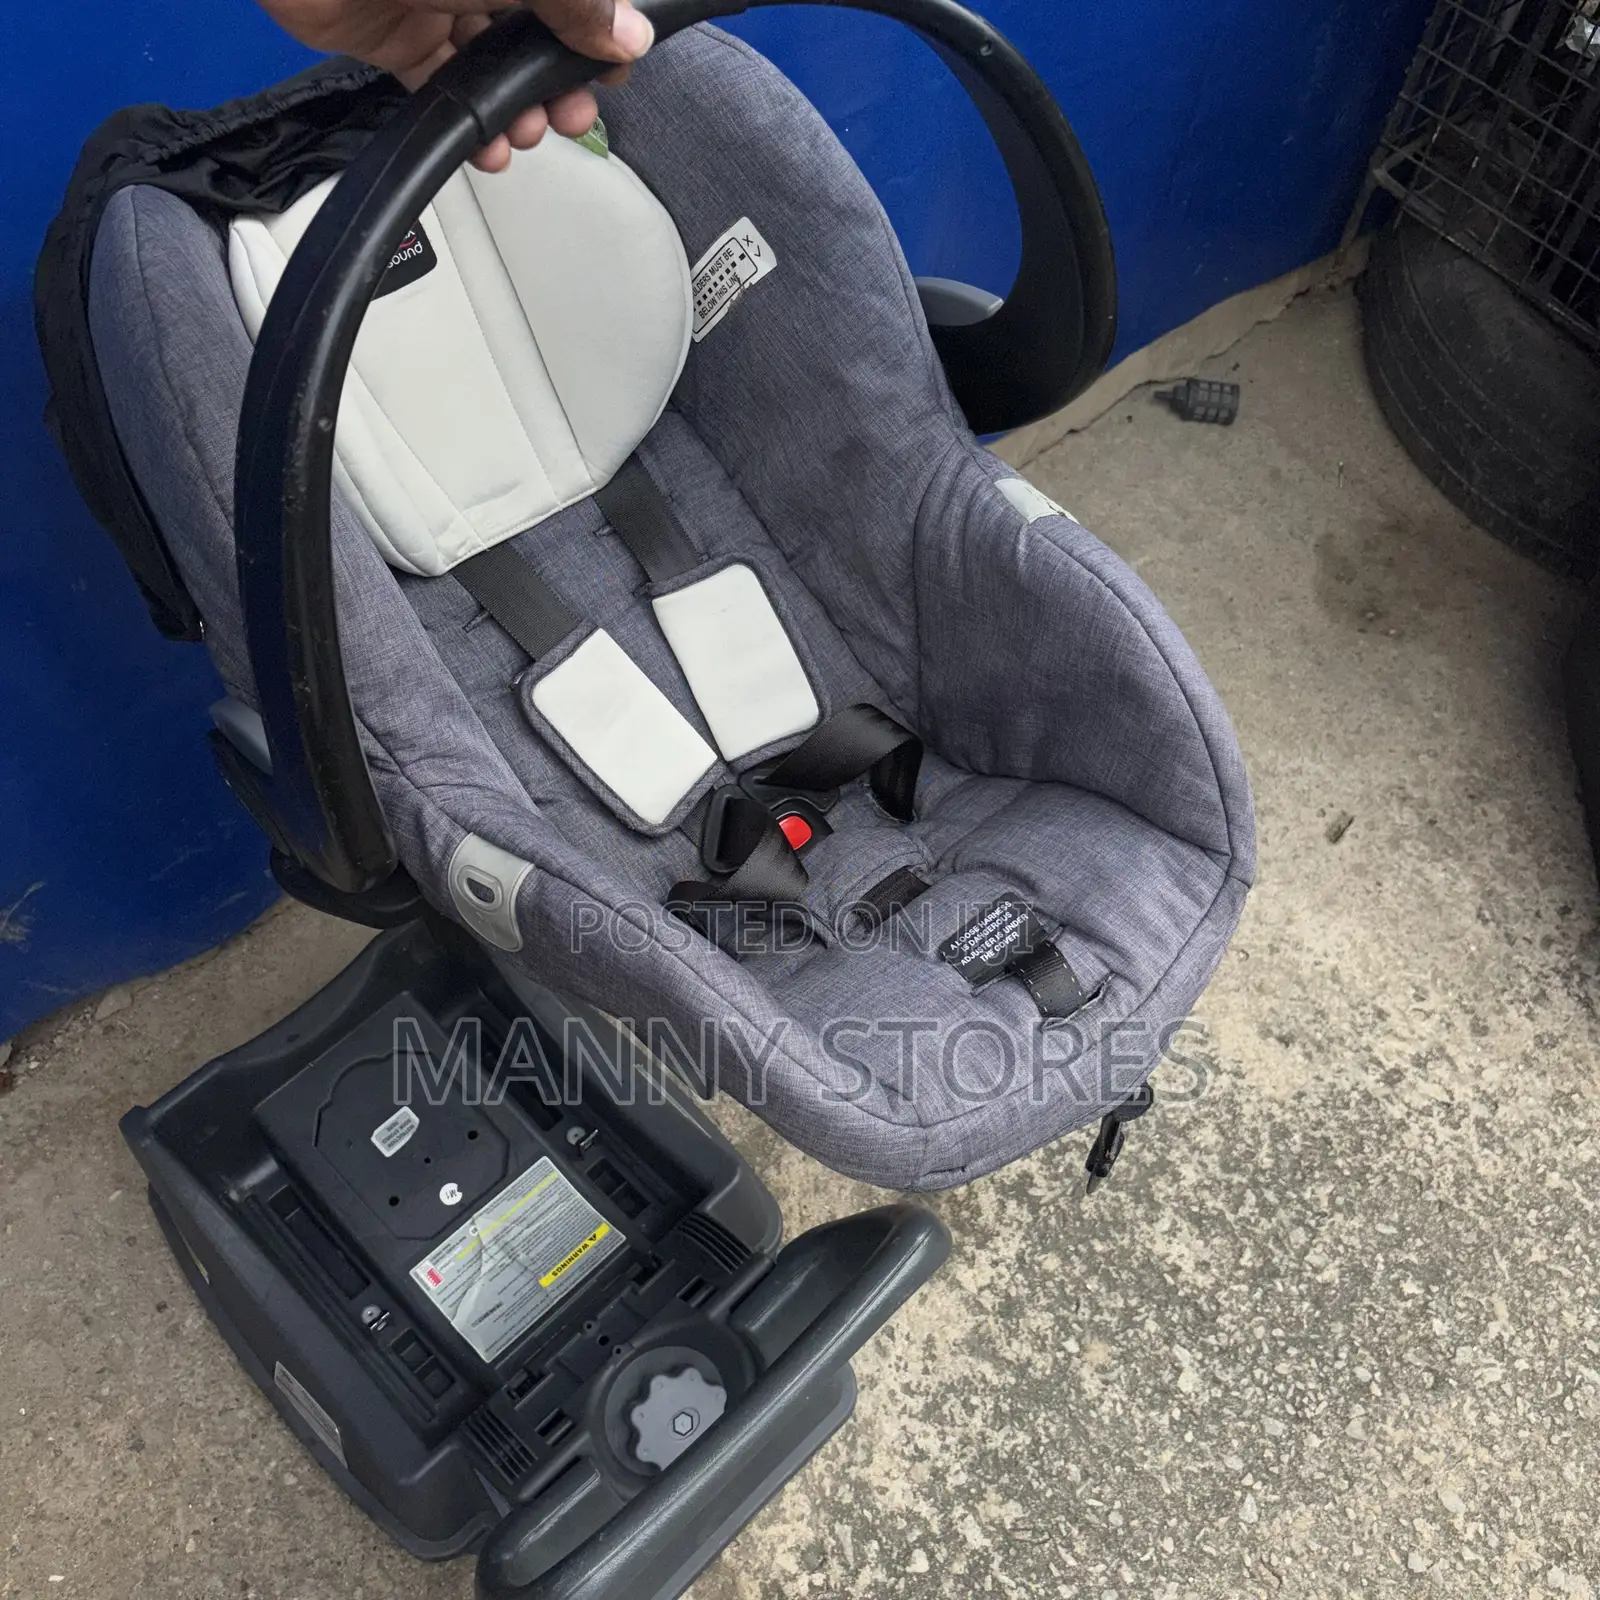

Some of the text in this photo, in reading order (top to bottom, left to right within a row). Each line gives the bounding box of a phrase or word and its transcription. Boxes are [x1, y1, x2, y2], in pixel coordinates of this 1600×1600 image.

[708, 257, 726, 276] MUST
[722, 247, 735, 260] BE
[698, 271, 741, 319] BELOW THIS LINE
[950, 901, 1012, 951] A LOOSE HARNESS
[960, 913, 1029, 966] ADJUSTER IS UNDER
[961, 911, 1013, 952] IS DANGEROUS
[979, 931, 1019, 962] THE COVER
[551, 1243, 590, 1277] WARNINGS
